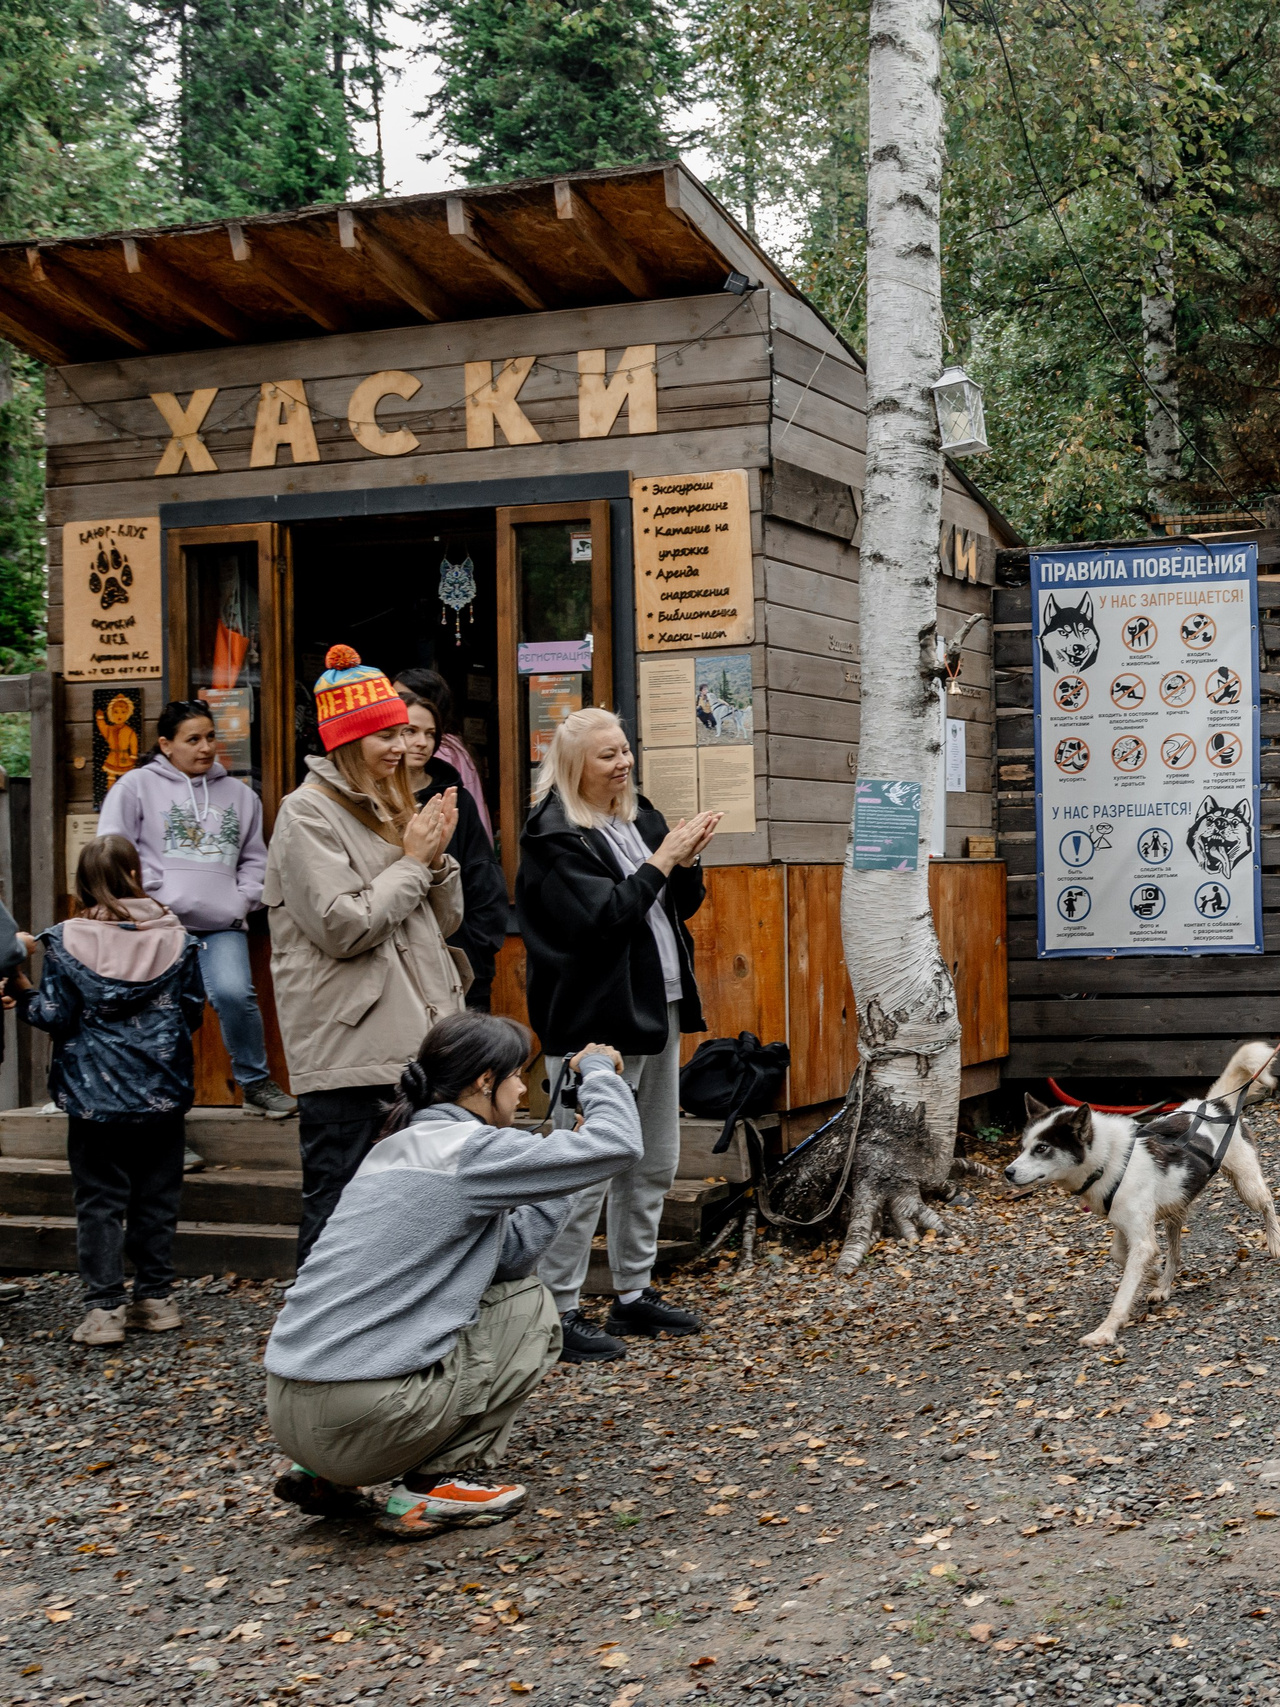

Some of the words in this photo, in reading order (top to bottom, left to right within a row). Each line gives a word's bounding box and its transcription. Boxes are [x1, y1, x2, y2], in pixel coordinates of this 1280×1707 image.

[150, 344, 657, 476] ХАСКИ
[652, 481, 713, 496] Экскурсии
[653, 501, 728, 519] Догтрекинг
[655, 523, 711, 537] Катание
[715, 523, 729, 532] на
[658, 545, 709, 561] упряжке
[656, 566, 699, 582] Аренда
[1041, 559, 1128, 583] ПРАВИЛА
[1133, 553, 1247, 578] ПОВЕДЕНИЯ
[660, 587, 730, 603] снаряжения
[1099, 595, 1107, 609] У
[1111, 594, 1138, 608] НАС
[1140, 589, 1244, 607] ЗАПРЕЩАЕТСЯ!
[658, 630, 727, 643] Хаски-шоп
[519, 650, 592, 663] РЕГИСТРАЦИЯ
[1052, 806, 1060, 820] У
[1063, 805, 1089, 820] НАС
[1093, 802, 1192, 819] РАЗРЕШАЕТСЯ!
